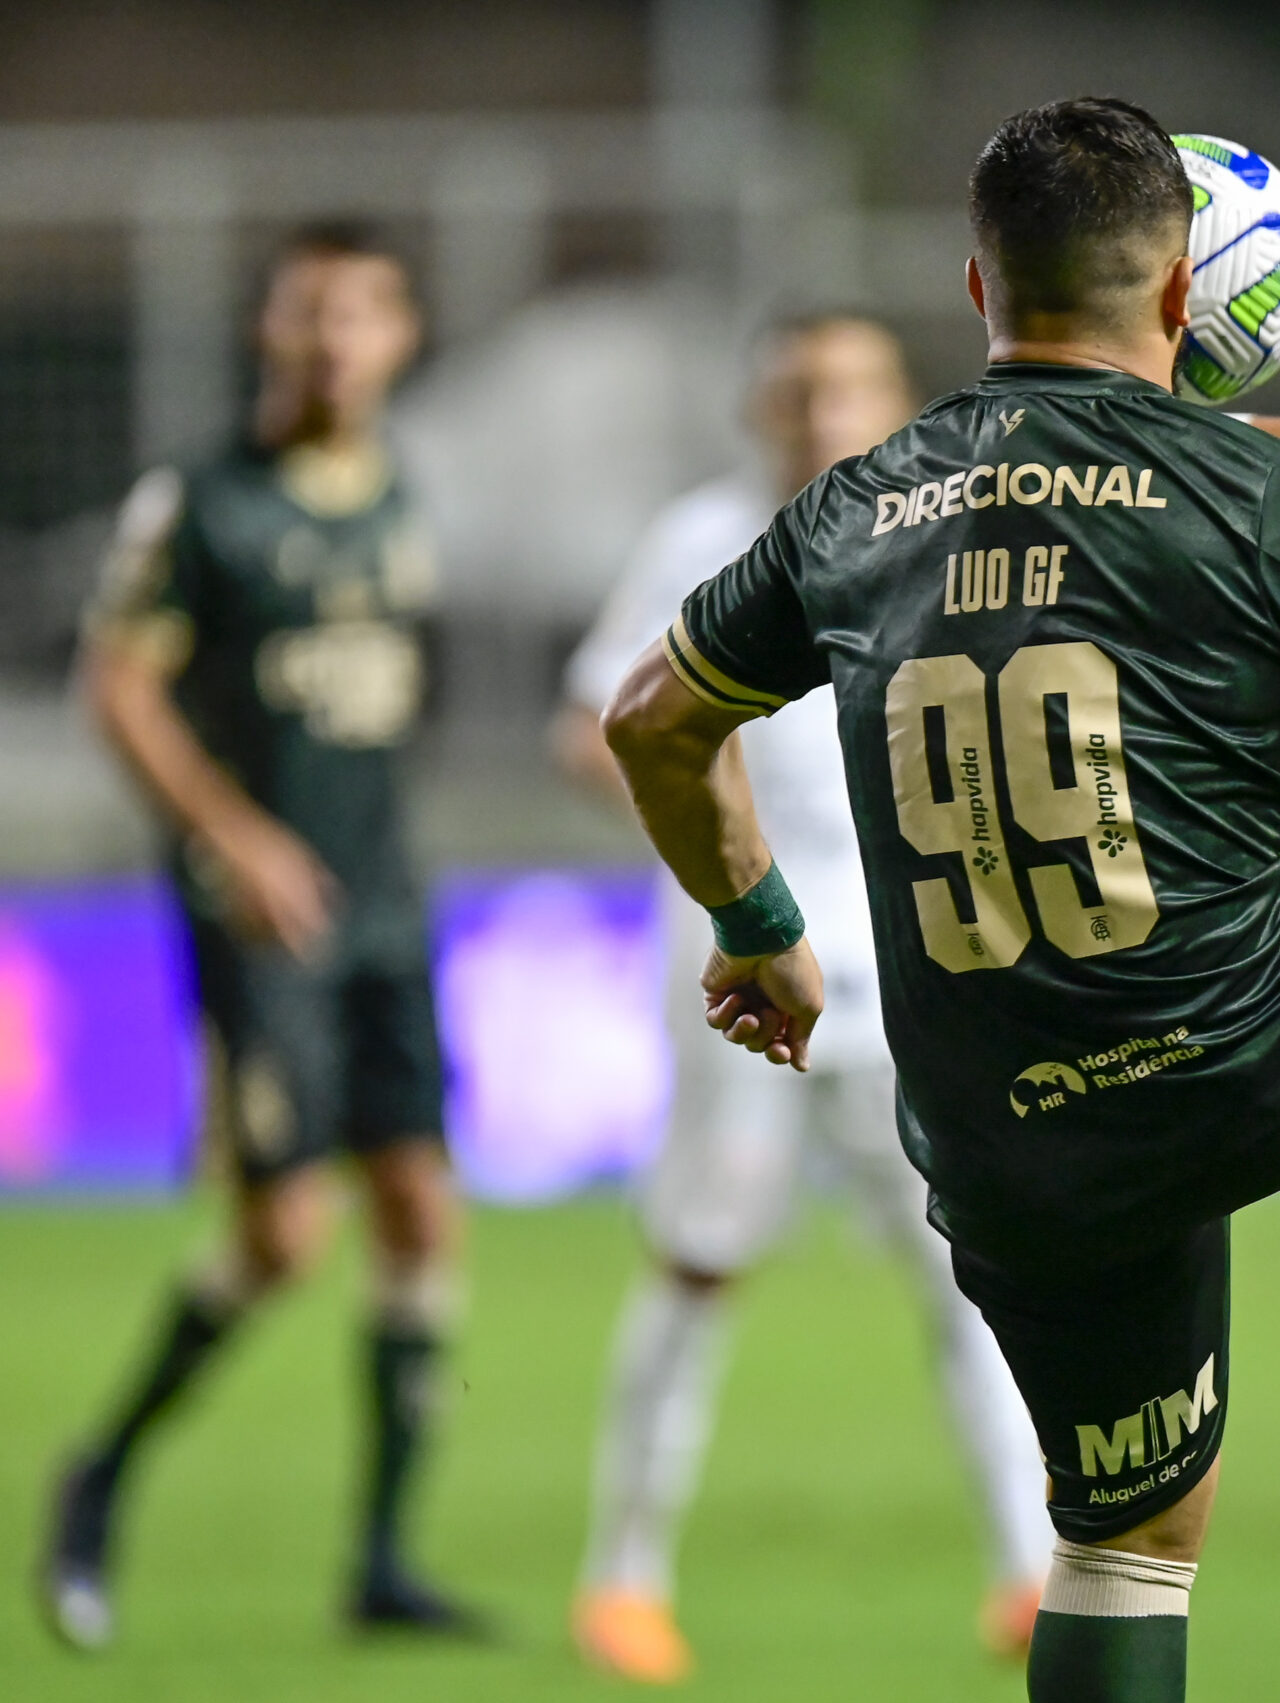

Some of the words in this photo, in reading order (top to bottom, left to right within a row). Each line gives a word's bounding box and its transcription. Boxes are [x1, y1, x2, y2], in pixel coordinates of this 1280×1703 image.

[871, 462, 1167, 537] DIRECIONAL
[943, 547, 1010, 616] LUO
[1022, 544, 1069, 607] GF
[884, 641, 1161, 974] 99
[960, 747, 991, 842] hapvida
[1086, 733, 1117, 826] hapvida
[1077, 1036, 1161, 1072] Hospital
[1162, 1025, 1190, 1047] na
[1092, 1044, 1205, 1089] Residência
[1038, 1092, 1067, 1112] HR
[1088, 1474, 1155, 1504] Aluguel
[1158, 1462, 1180, 1483] de
